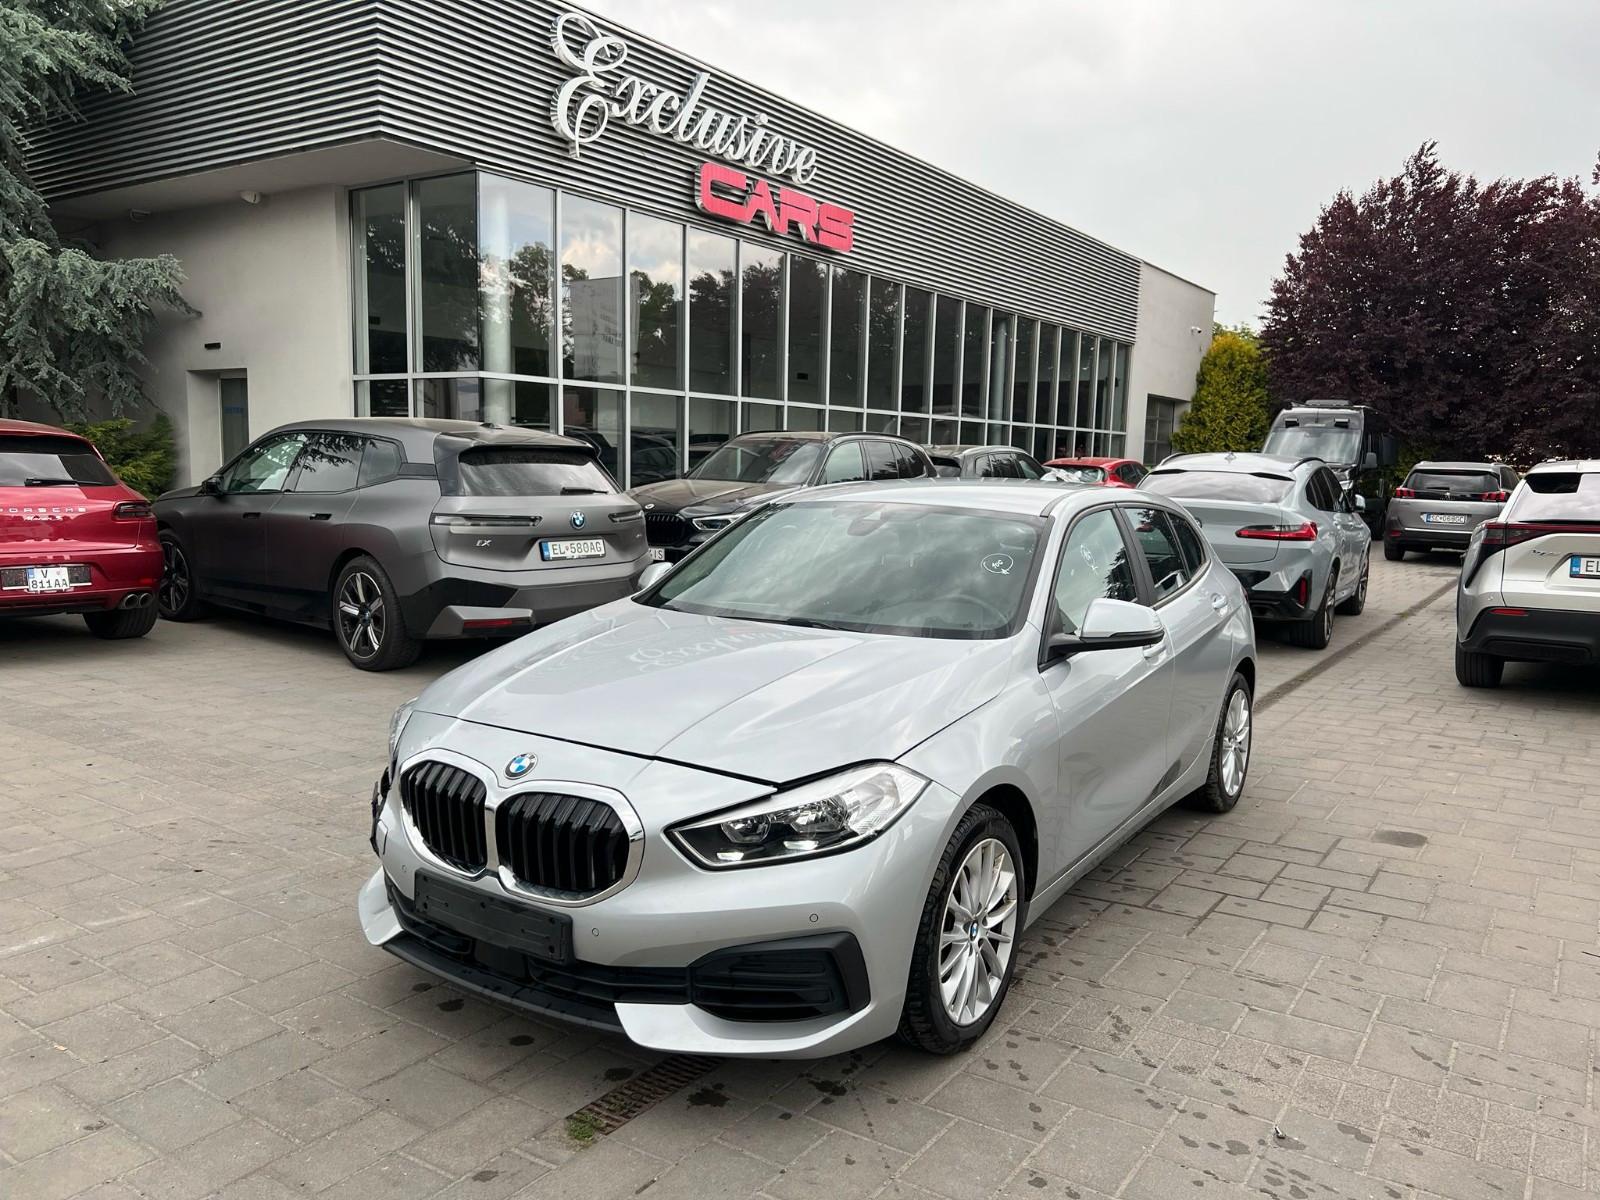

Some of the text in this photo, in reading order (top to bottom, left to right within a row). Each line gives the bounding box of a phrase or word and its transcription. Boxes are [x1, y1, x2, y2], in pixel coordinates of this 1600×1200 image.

[551, 12, 818, 185] Exclusive
[695, 162, 855, 252] CARS
[31, 579, 68, 589] 811AA
[41, 569, 48, 578] V
